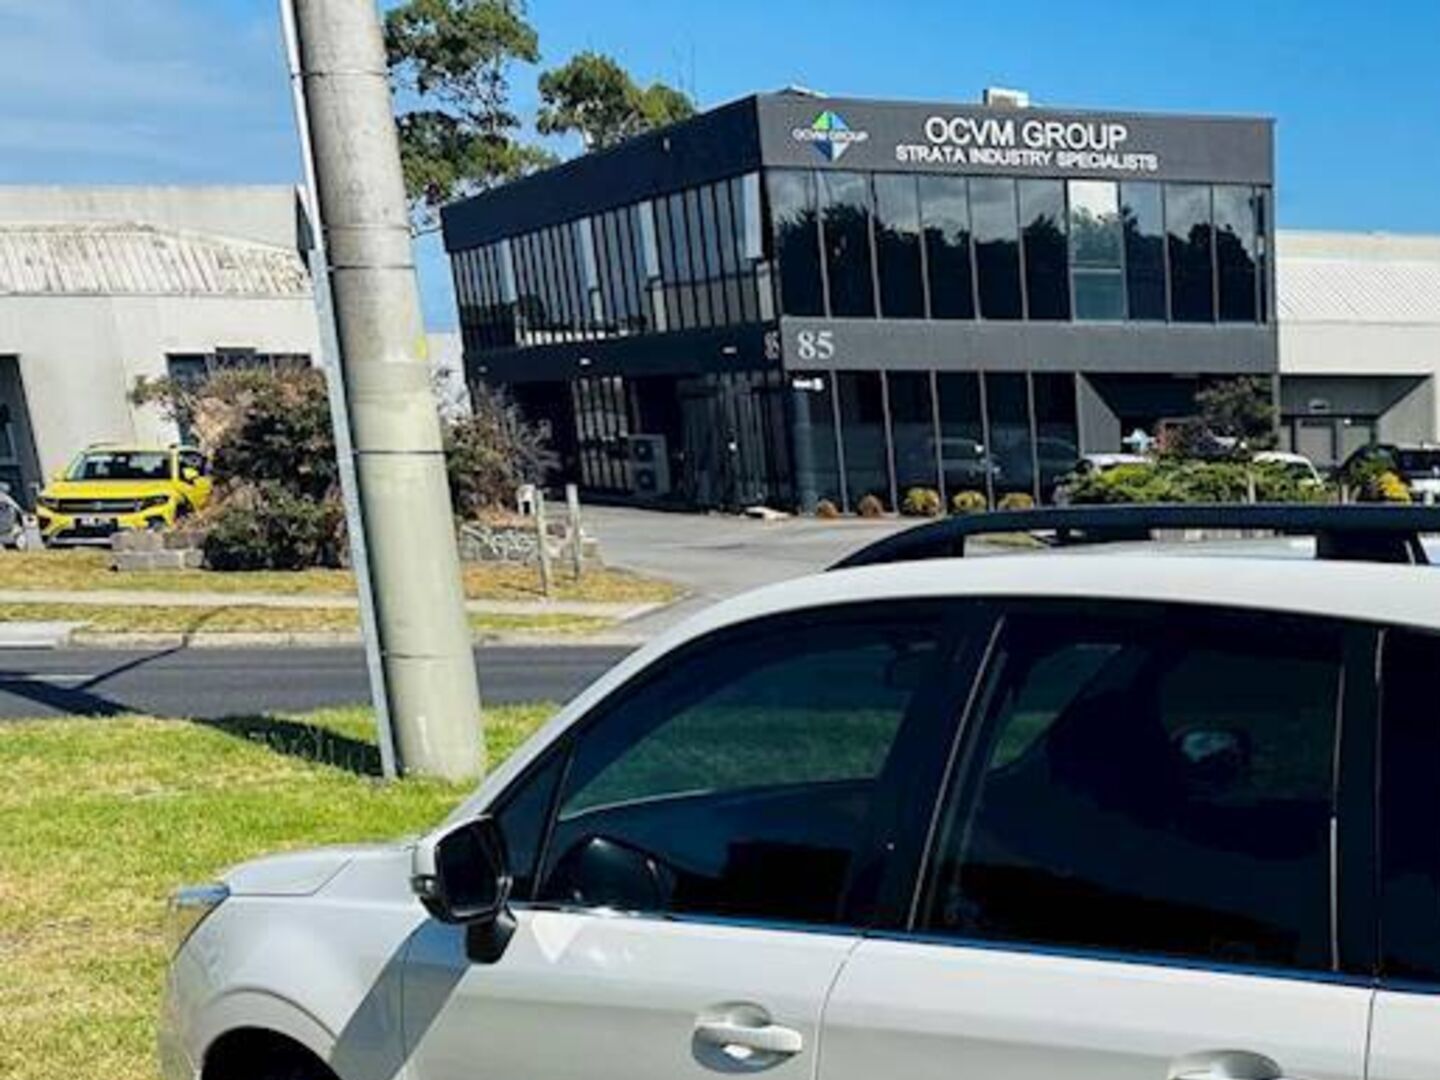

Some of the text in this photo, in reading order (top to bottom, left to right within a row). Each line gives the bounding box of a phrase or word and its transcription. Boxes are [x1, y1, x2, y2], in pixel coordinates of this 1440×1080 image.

[924, 116, 1128, 150] OCVM GROUP
[895, 145, 1159, 171] STRATA INDUSTRY SPECIALISTS
[797, 331, 835, 360] 85
